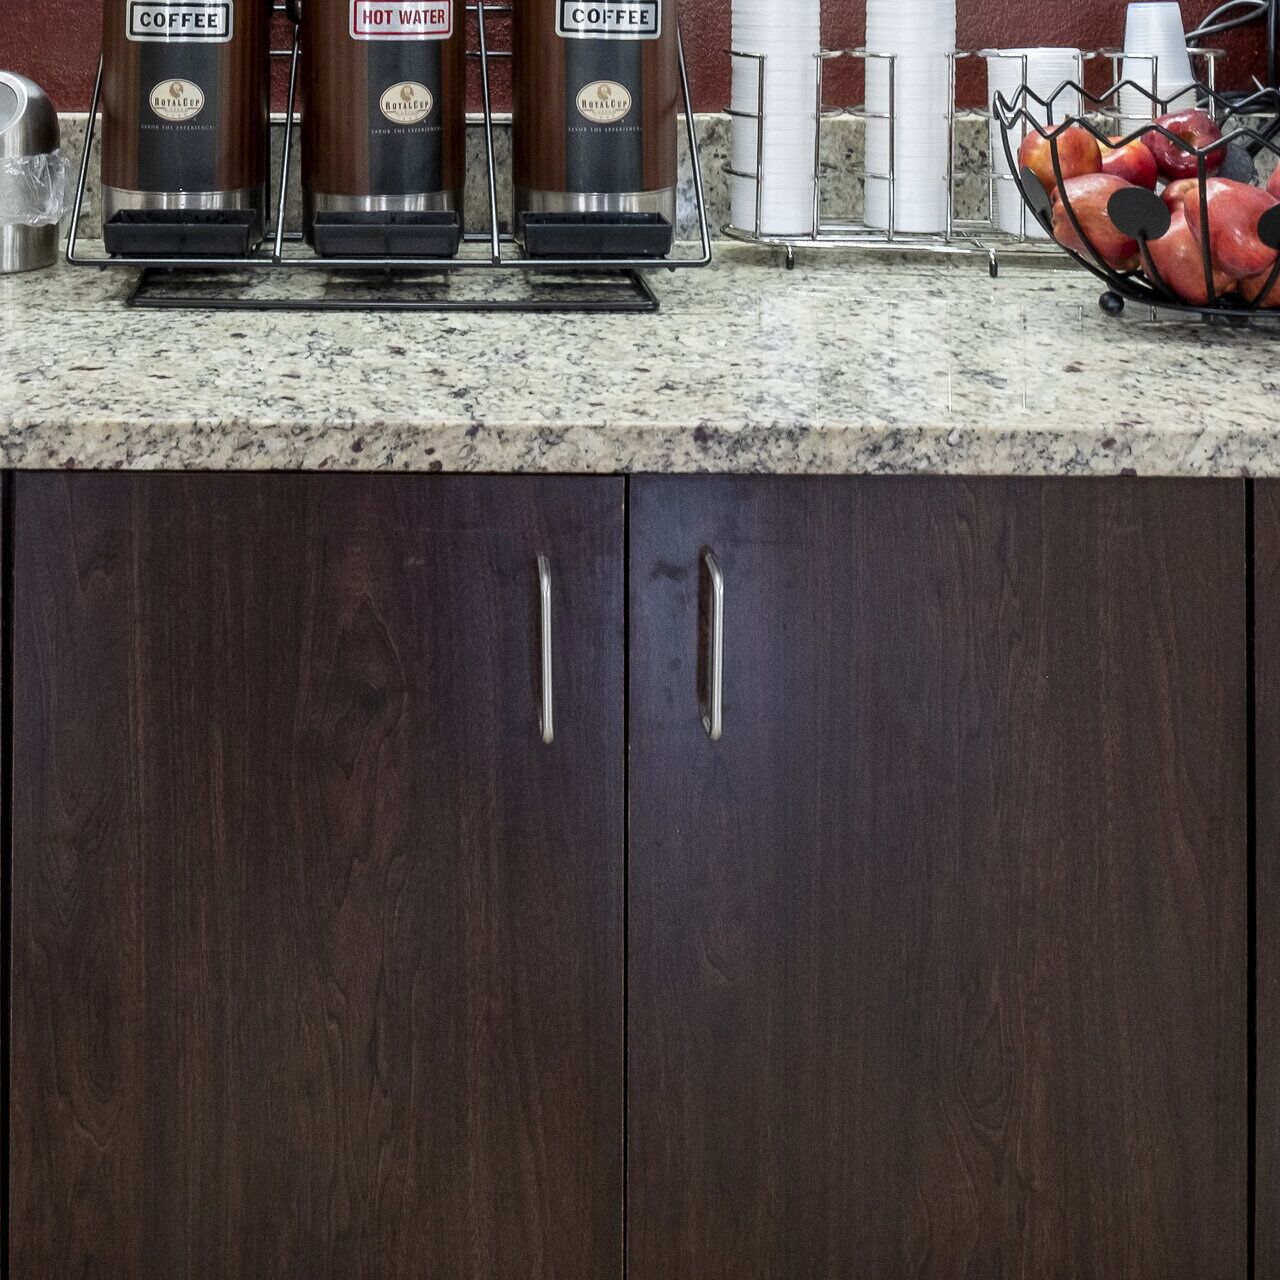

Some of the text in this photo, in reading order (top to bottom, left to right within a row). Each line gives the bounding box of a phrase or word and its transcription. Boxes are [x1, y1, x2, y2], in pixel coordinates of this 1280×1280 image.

[140, 12, 218, 28] COFFEE
[363, 9, 445, 25] HOT WATER
[572, 8, 649, 25] COFFEE
